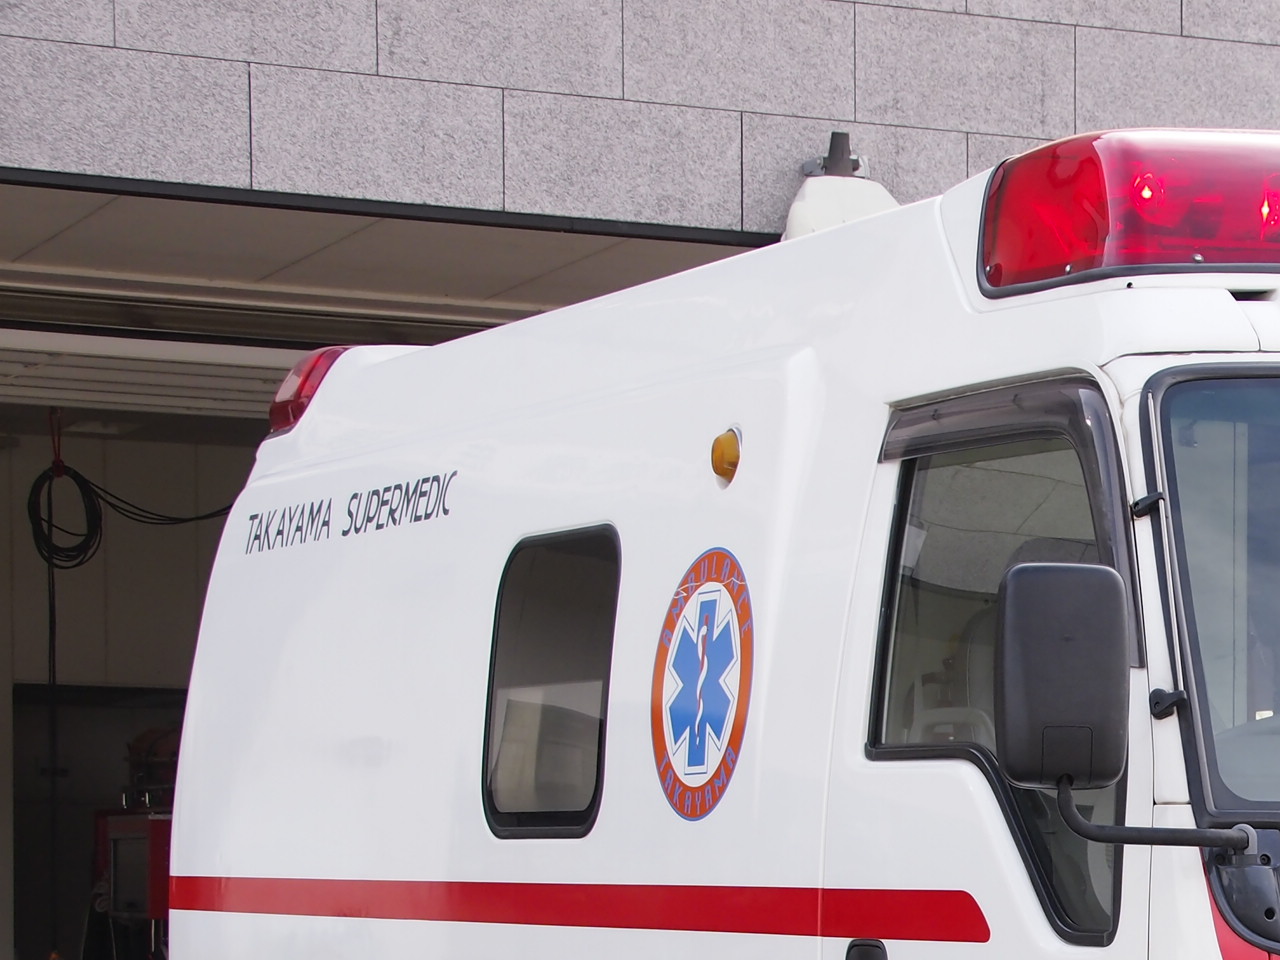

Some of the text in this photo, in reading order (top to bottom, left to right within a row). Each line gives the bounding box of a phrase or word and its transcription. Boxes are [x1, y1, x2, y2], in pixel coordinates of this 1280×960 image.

[244, 470, 458, 555] TAKAYAMA SUPERMEDIC
[663, 556, 752, 648] AMBULANCE
[660, 746, 737, 815] TAKAYAMA
